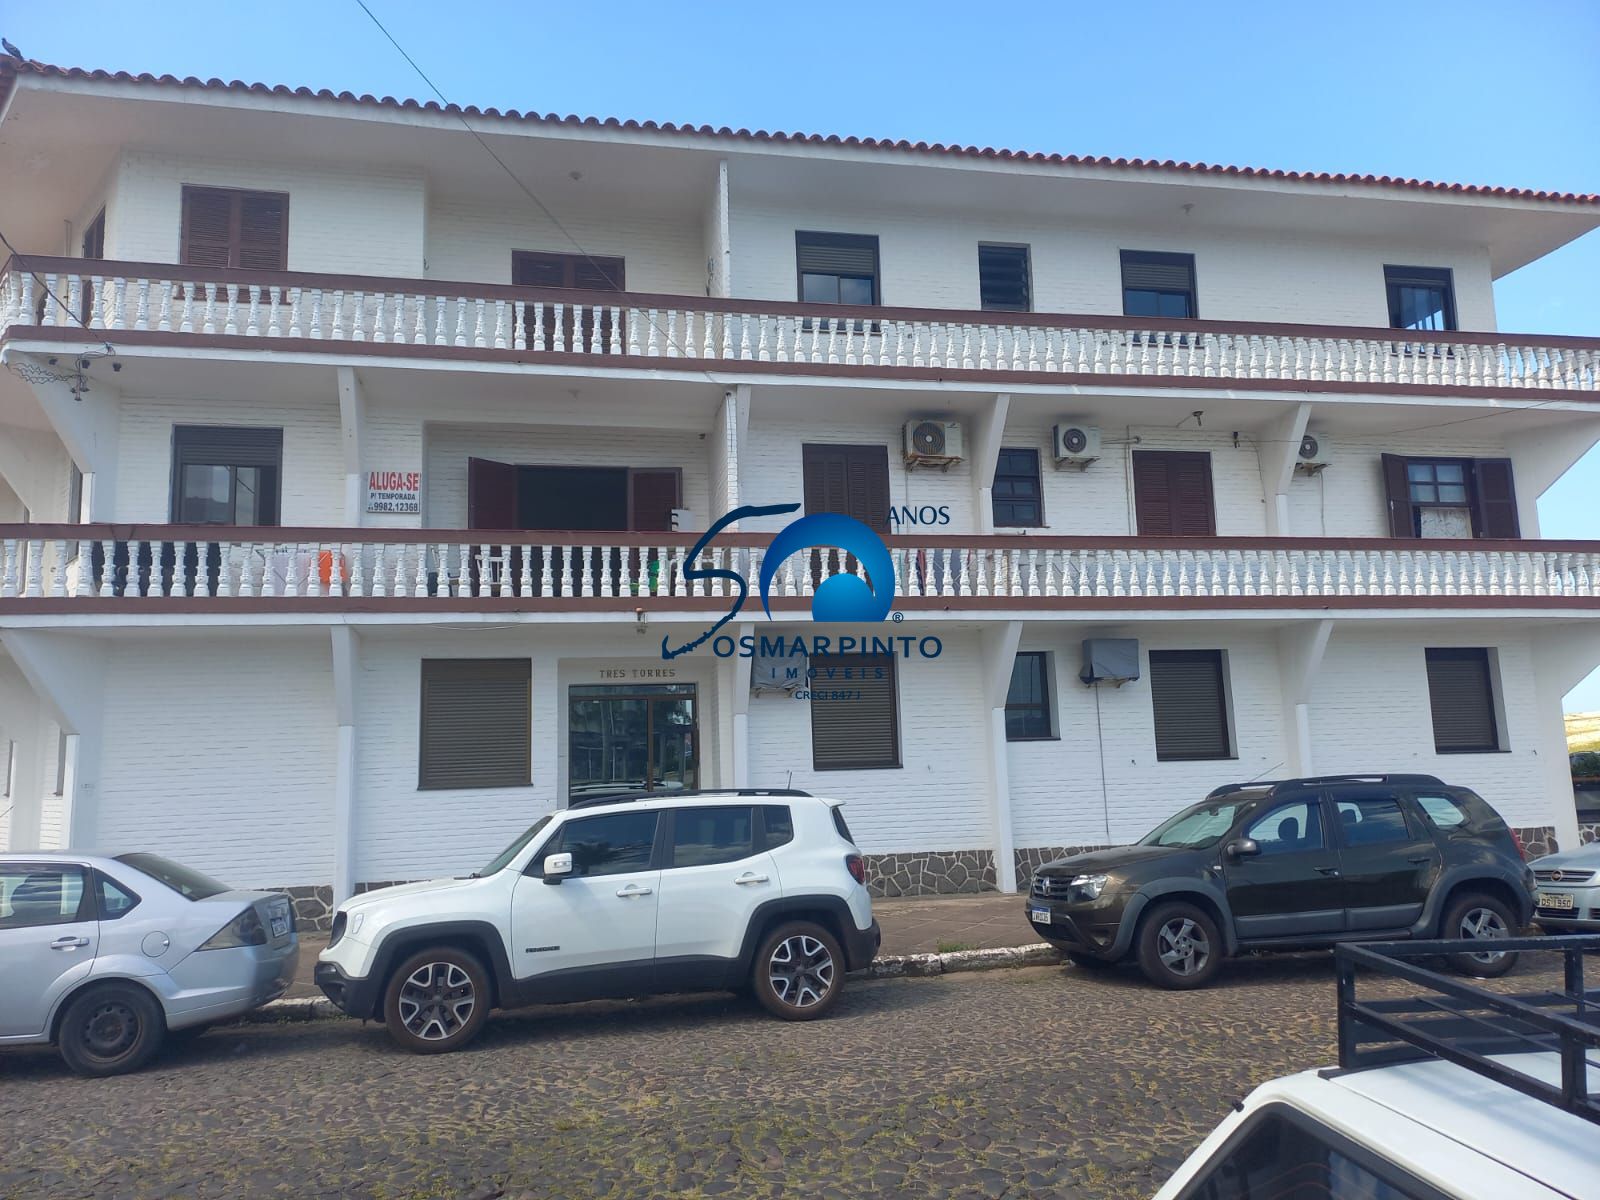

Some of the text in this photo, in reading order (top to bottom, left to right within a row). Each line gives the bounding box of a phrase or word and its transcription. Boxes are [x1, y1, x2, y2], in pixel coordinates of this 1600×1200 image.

[369, 471, 419, 491] ALUGA-SE
[600, 668, 676, 678] TRES TORRES
